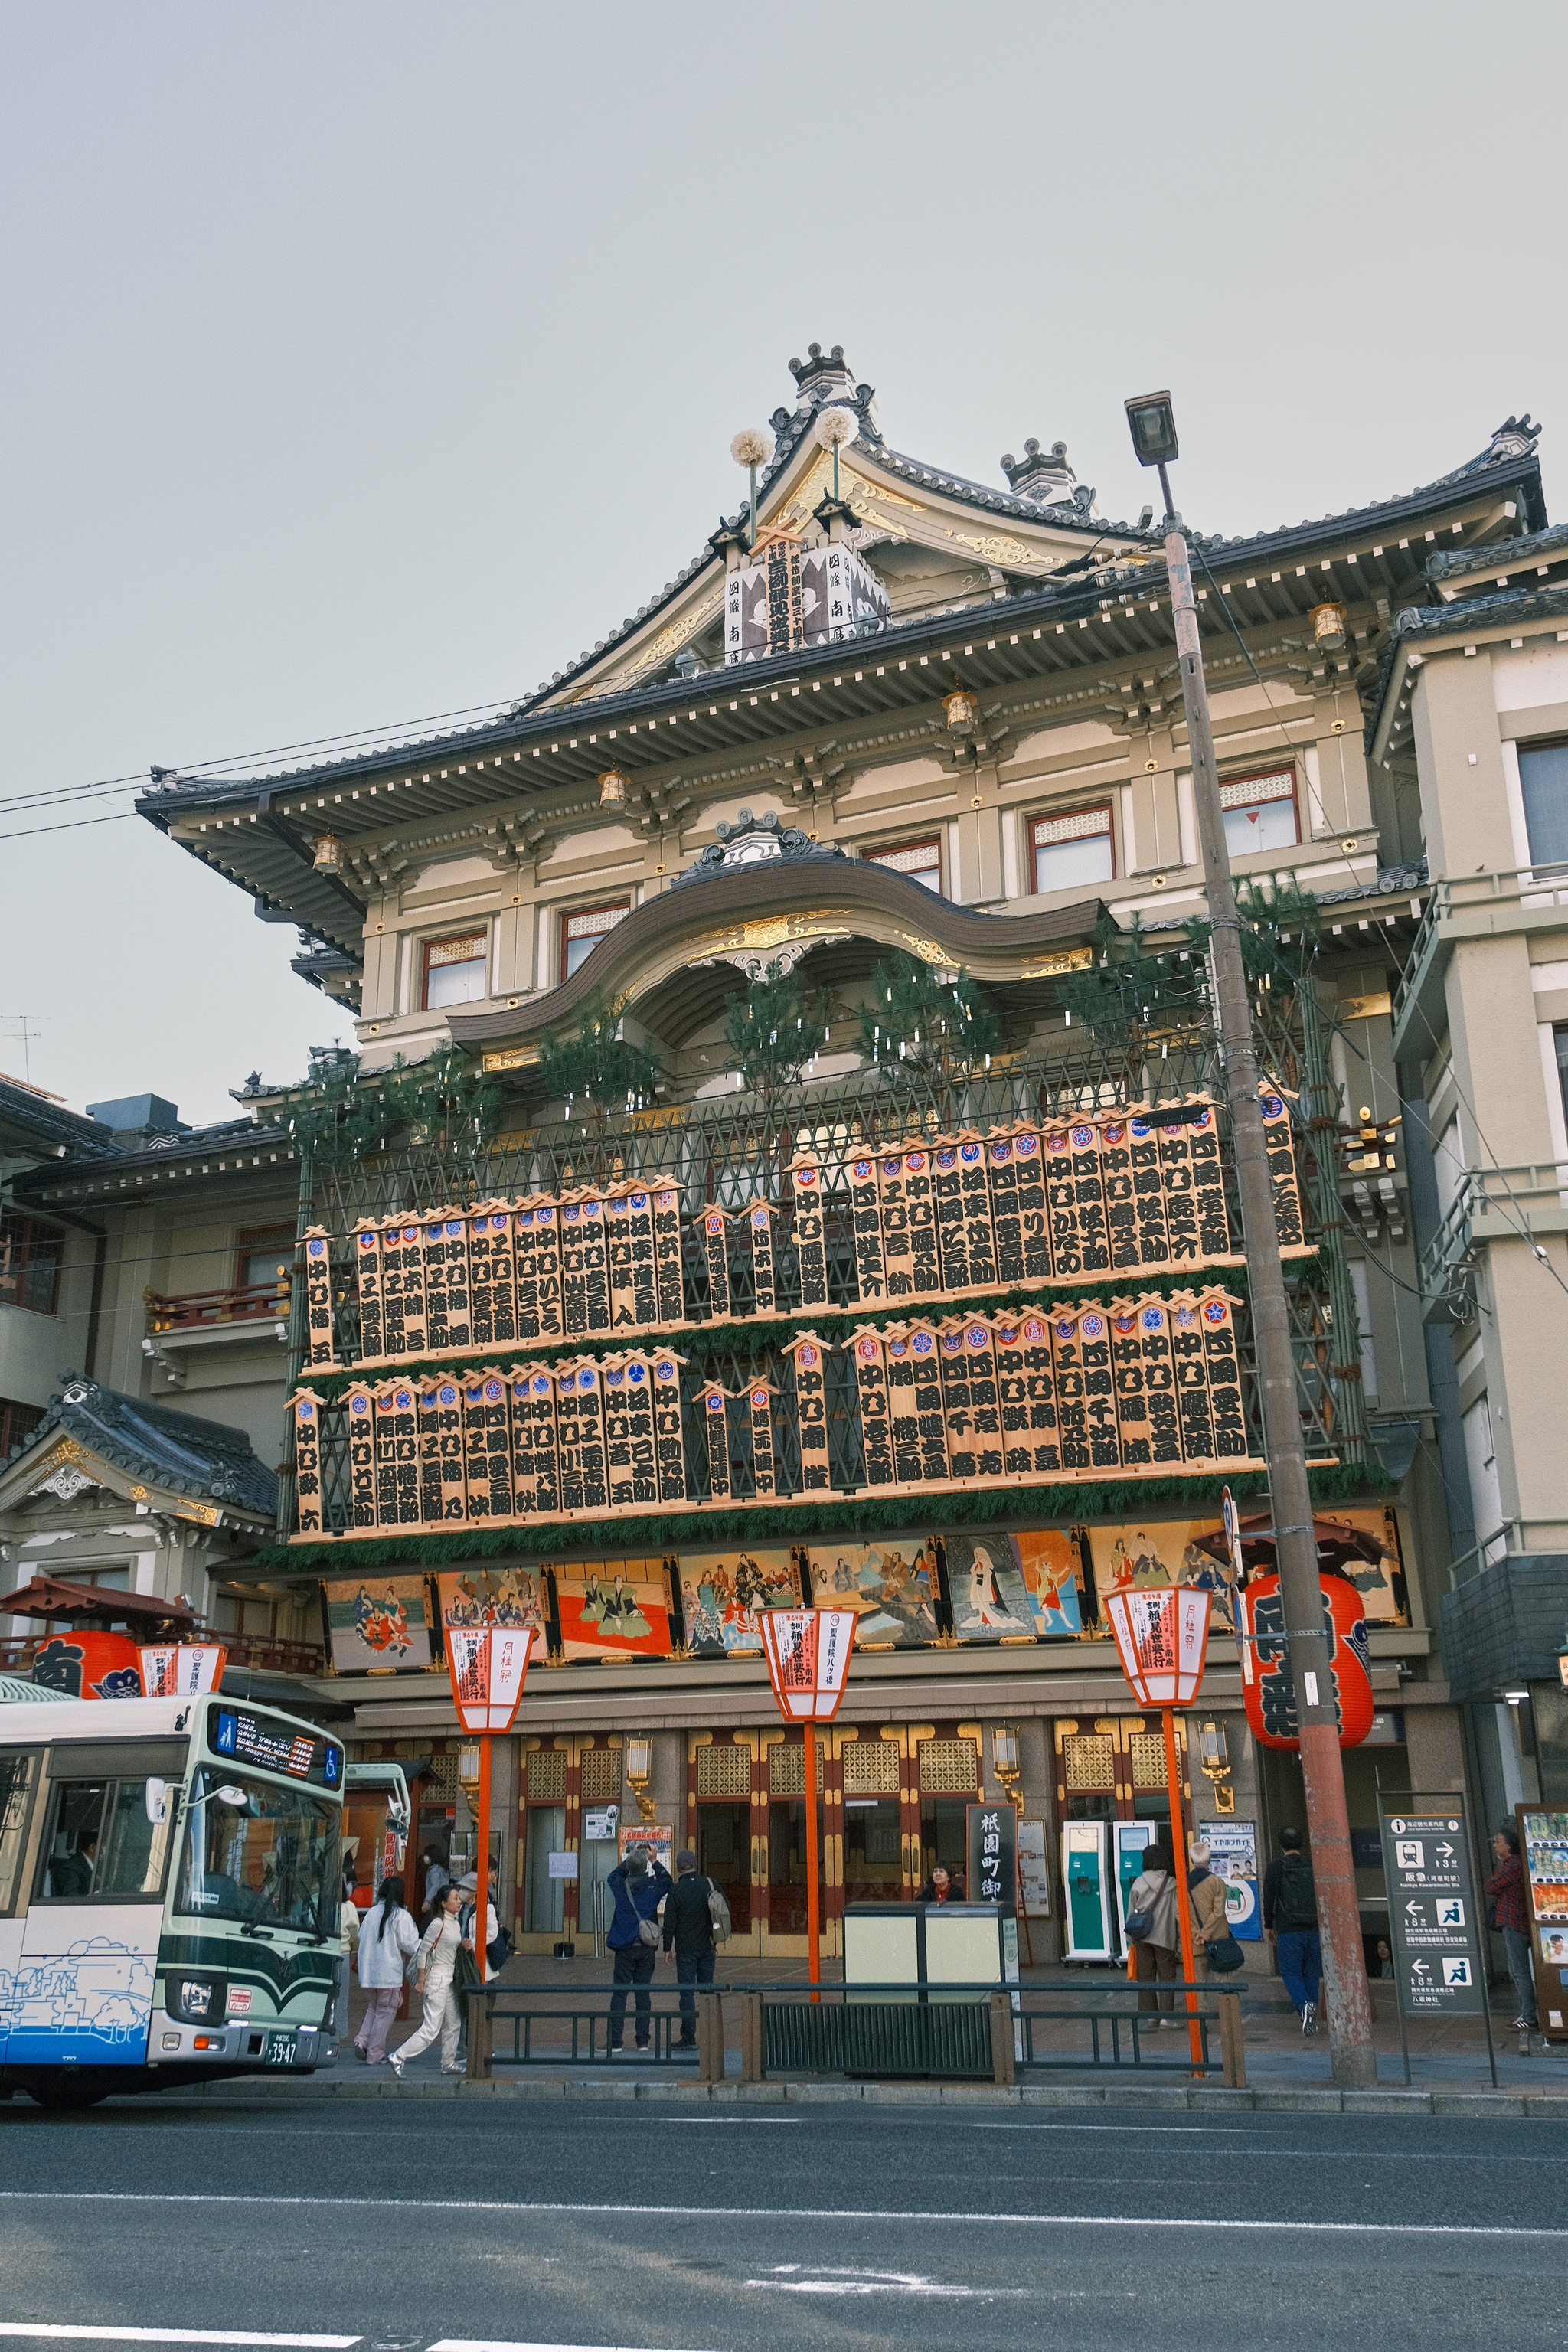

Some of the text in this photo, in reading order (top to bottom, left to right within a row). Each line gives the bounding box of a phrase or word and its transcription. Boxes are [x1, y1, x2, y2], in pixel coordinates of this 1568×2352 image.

[155, 1658, 166, 1697] 吉例顔見世
[980, 1811, 1001, 1902] 祇園町御
[1442, 1860, 1449, 1868] 3
[1411, 1918, 1419, 1926] 8
[1418, 1977, 1425, 1985] 8
